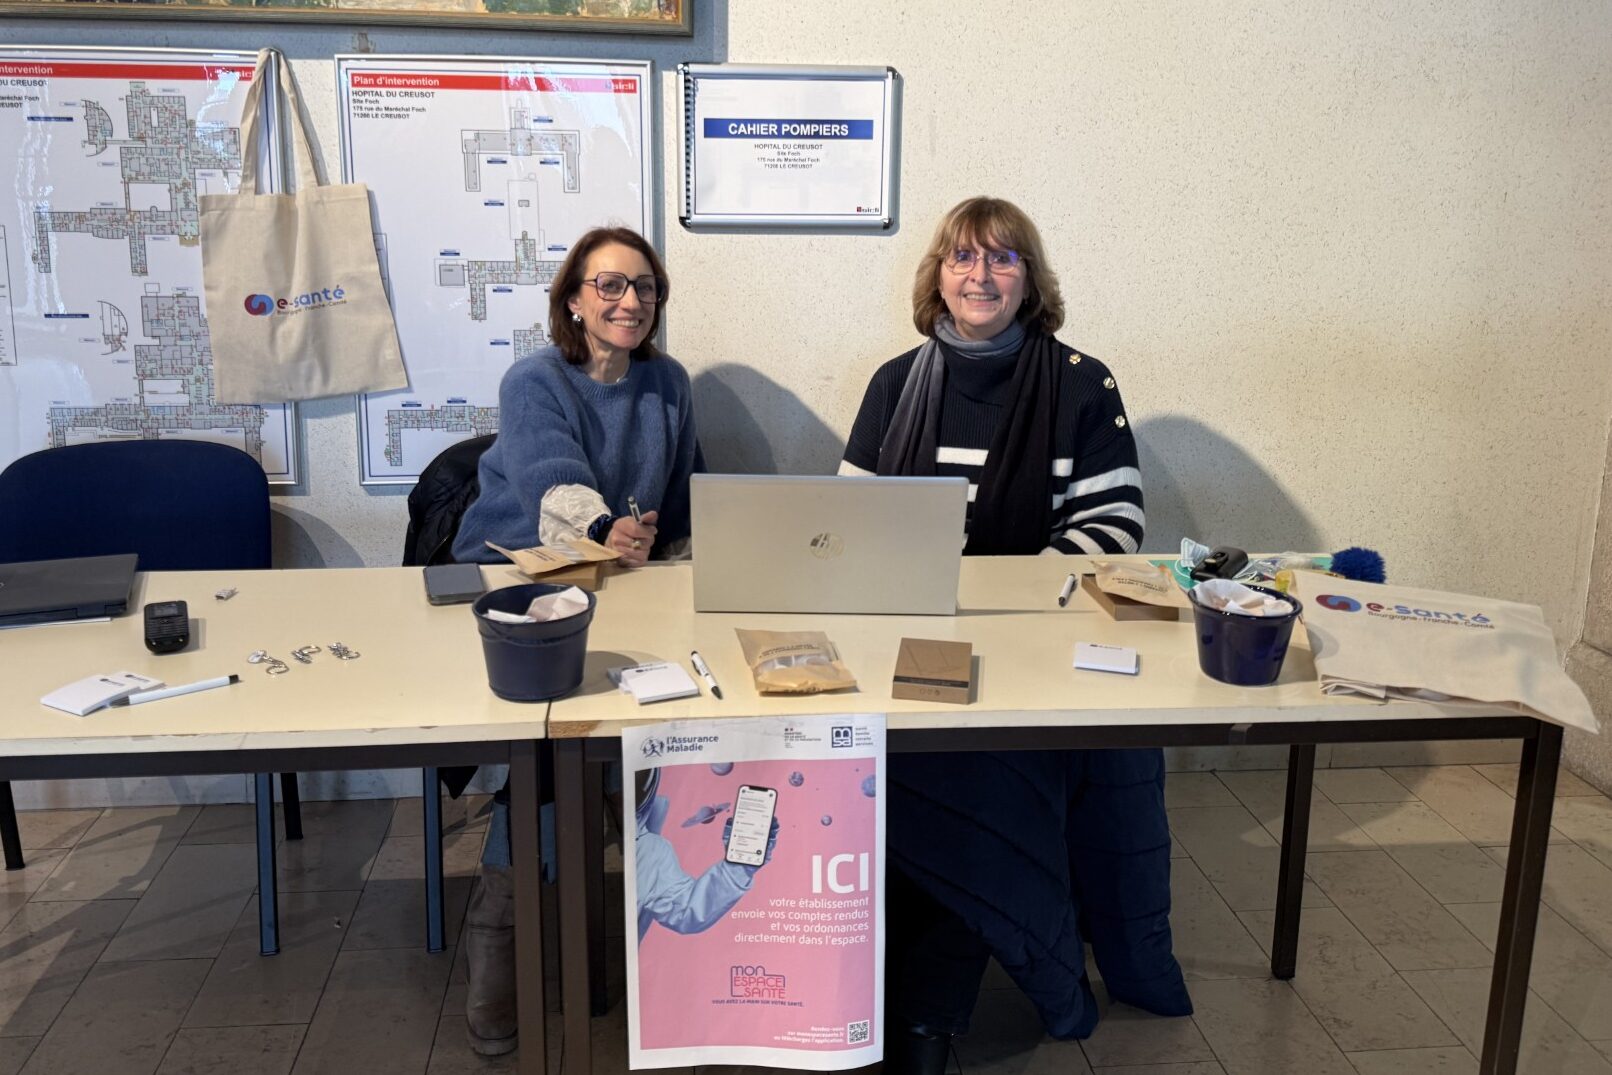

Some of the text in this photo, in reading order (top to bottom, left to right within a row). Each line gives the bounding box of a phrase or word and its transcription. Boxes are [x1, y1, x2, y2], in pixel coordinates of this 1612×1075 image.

[353, 76, 440, 86] Plan d'intervention
[728, 123, 849, 136] CAHIER POMPIERS
[276, 284, 345, 310] e-santé
[1365, 602, 1491, 624] e-santé
[666, 735, 720, 745] l'Assurance
[666, 743, 704, 753] Maladie
[812, 852, 869, 894] ICI
[769, 897, 869, 909] votre établissement
[731, 909, 869, 924] envoie vos comptes rendus
[770, 922, 869, 933] et vos ordonnances
[734, 933, 869, 947] directement dans l'espace.
[733, 976, 782, 987] ESPACE
